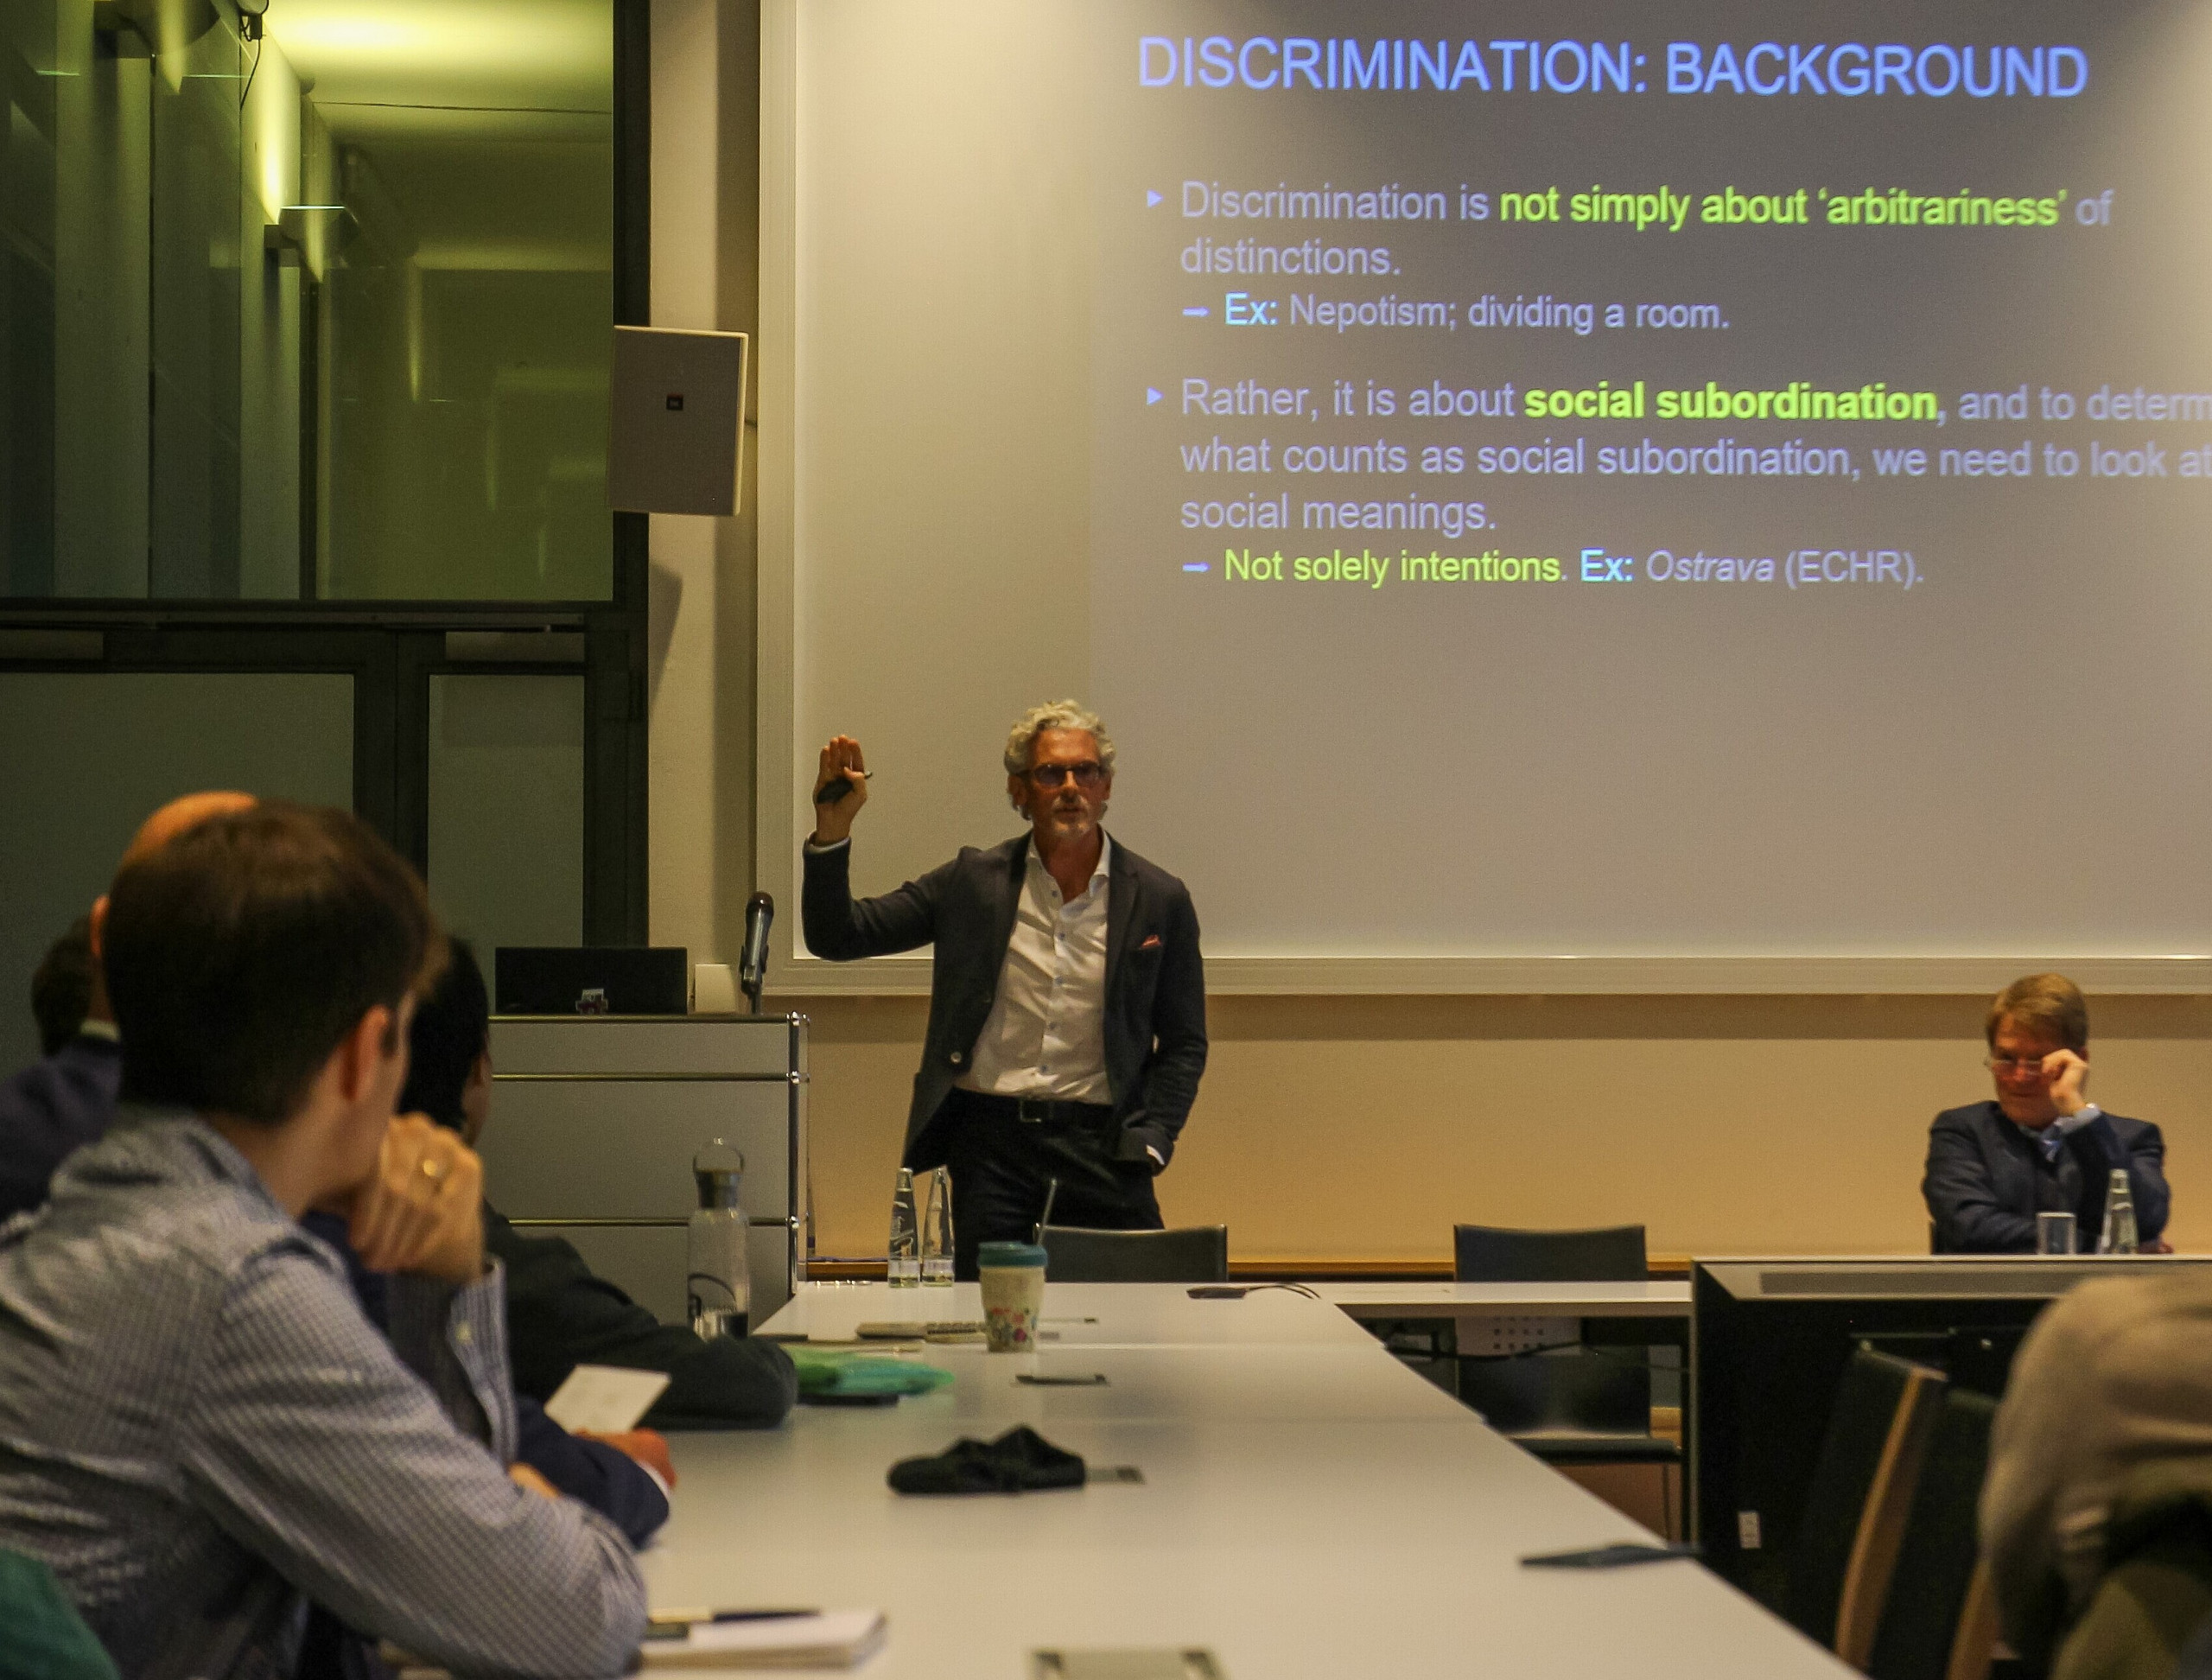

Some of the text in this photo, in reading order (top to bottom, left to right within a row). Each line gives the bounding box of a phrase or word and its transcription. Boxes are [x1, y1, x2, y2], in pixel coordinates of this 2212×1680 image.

[1138, 36, 2088, 98] DISCRIMINATION: BACKGROUND
[1181, 180, 1446, 220] Discrimination
[1459, 183, 1490, 220] is
[1499, 185, 1560, 222] not
[1570, 184, 1691, 232] simply
[1700, 186, 1808, 225] about
[2075, 190, 2114, 226] of
[1180, 239, 1401, 274] distinctions.
[1224, 291, 1729, 334] Ex: Nepotism; dividing a room.
[1182, 378, 1319, 421] Rather,
[1333, 380, 1355, 416] it
[1367, 380, 1396, 416] is
[1409, 380, 1516, 417] about
[1524, 381, 1644, 418] social
[1656, 381, 1947, 426] subordination,
[1959, 385, 2027, 420] and
[2040, 386, 2075, 420] to
[1181, 437, 2212, 480] what counts as social subordination, we need to look at
[1181, 493, 1495, 538] social meanings.
[1225, 549, 1924, 589] Not solely intentions. Ex: Ostrava (ECHR).
